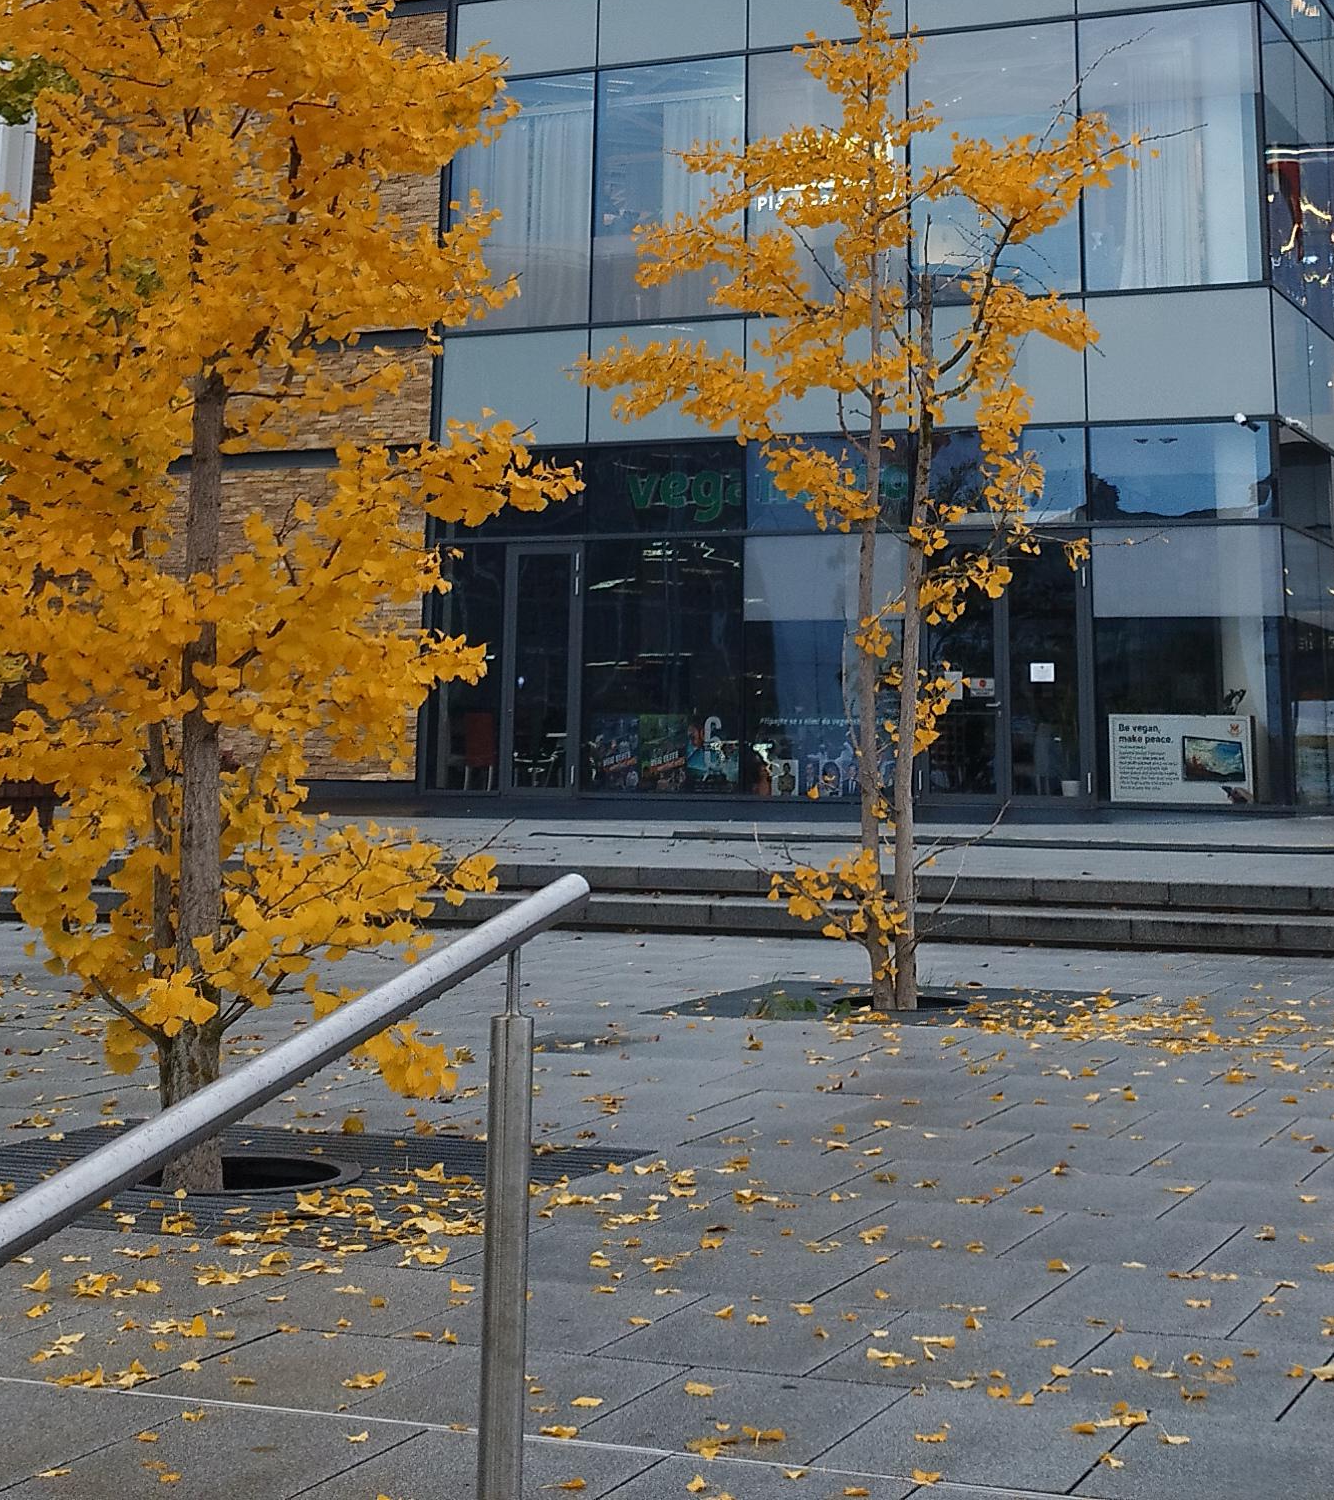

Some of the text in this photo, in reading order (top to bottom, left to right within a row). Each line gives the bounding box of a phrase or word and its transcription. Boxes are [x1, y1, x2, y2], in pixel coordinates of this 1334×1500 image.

[1118, 723, 1161, 734] Be vegan,
[1118, 735, 1174, 745] make peace.
